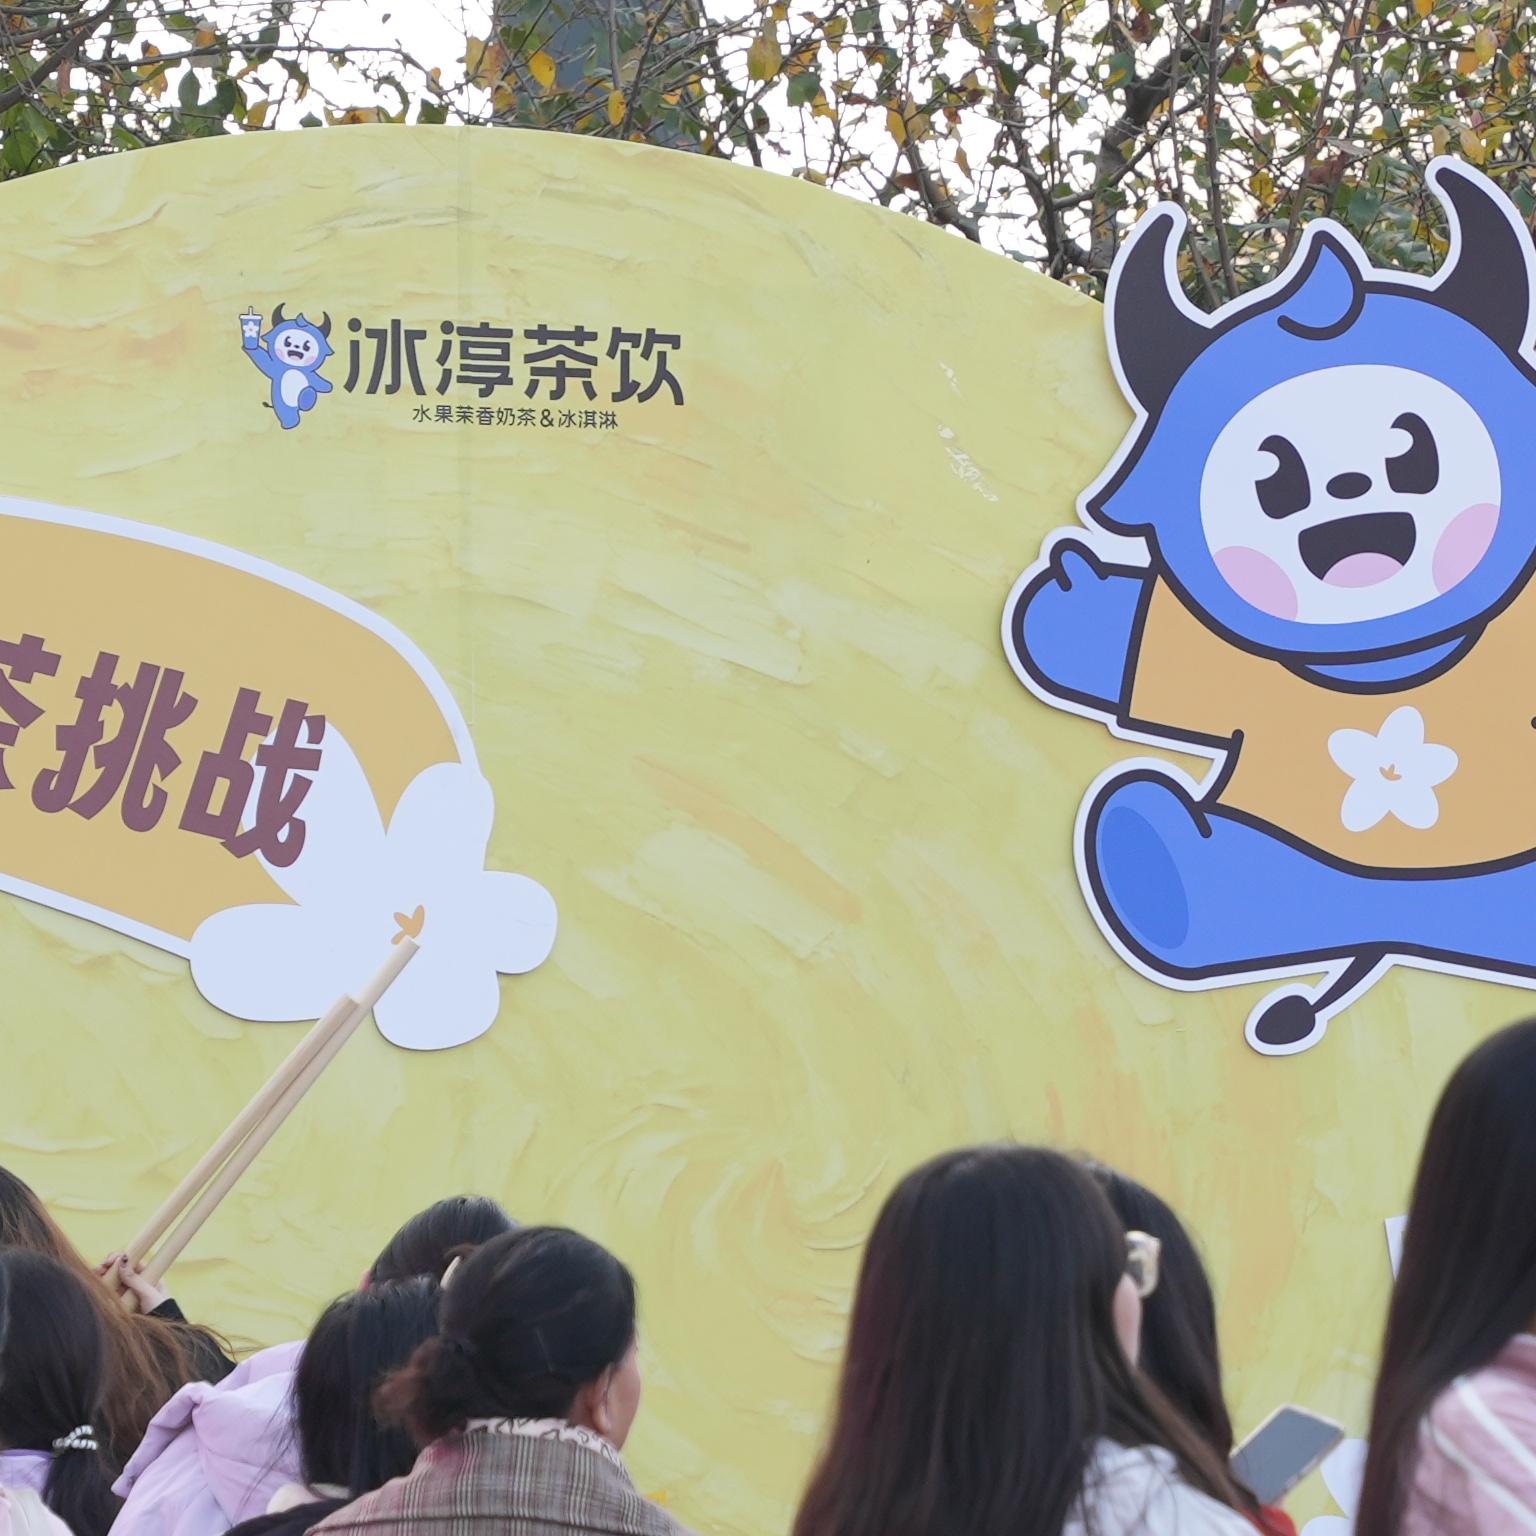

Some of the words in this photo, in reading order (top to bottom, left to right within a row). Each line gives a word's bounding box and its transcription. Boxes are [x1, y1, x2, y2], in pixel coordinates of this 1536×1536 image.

[343, 316, 685, 406] 冰淳茶饮
[411, 403, 619, 431] 水果茉香奶茶&冰淇淋
